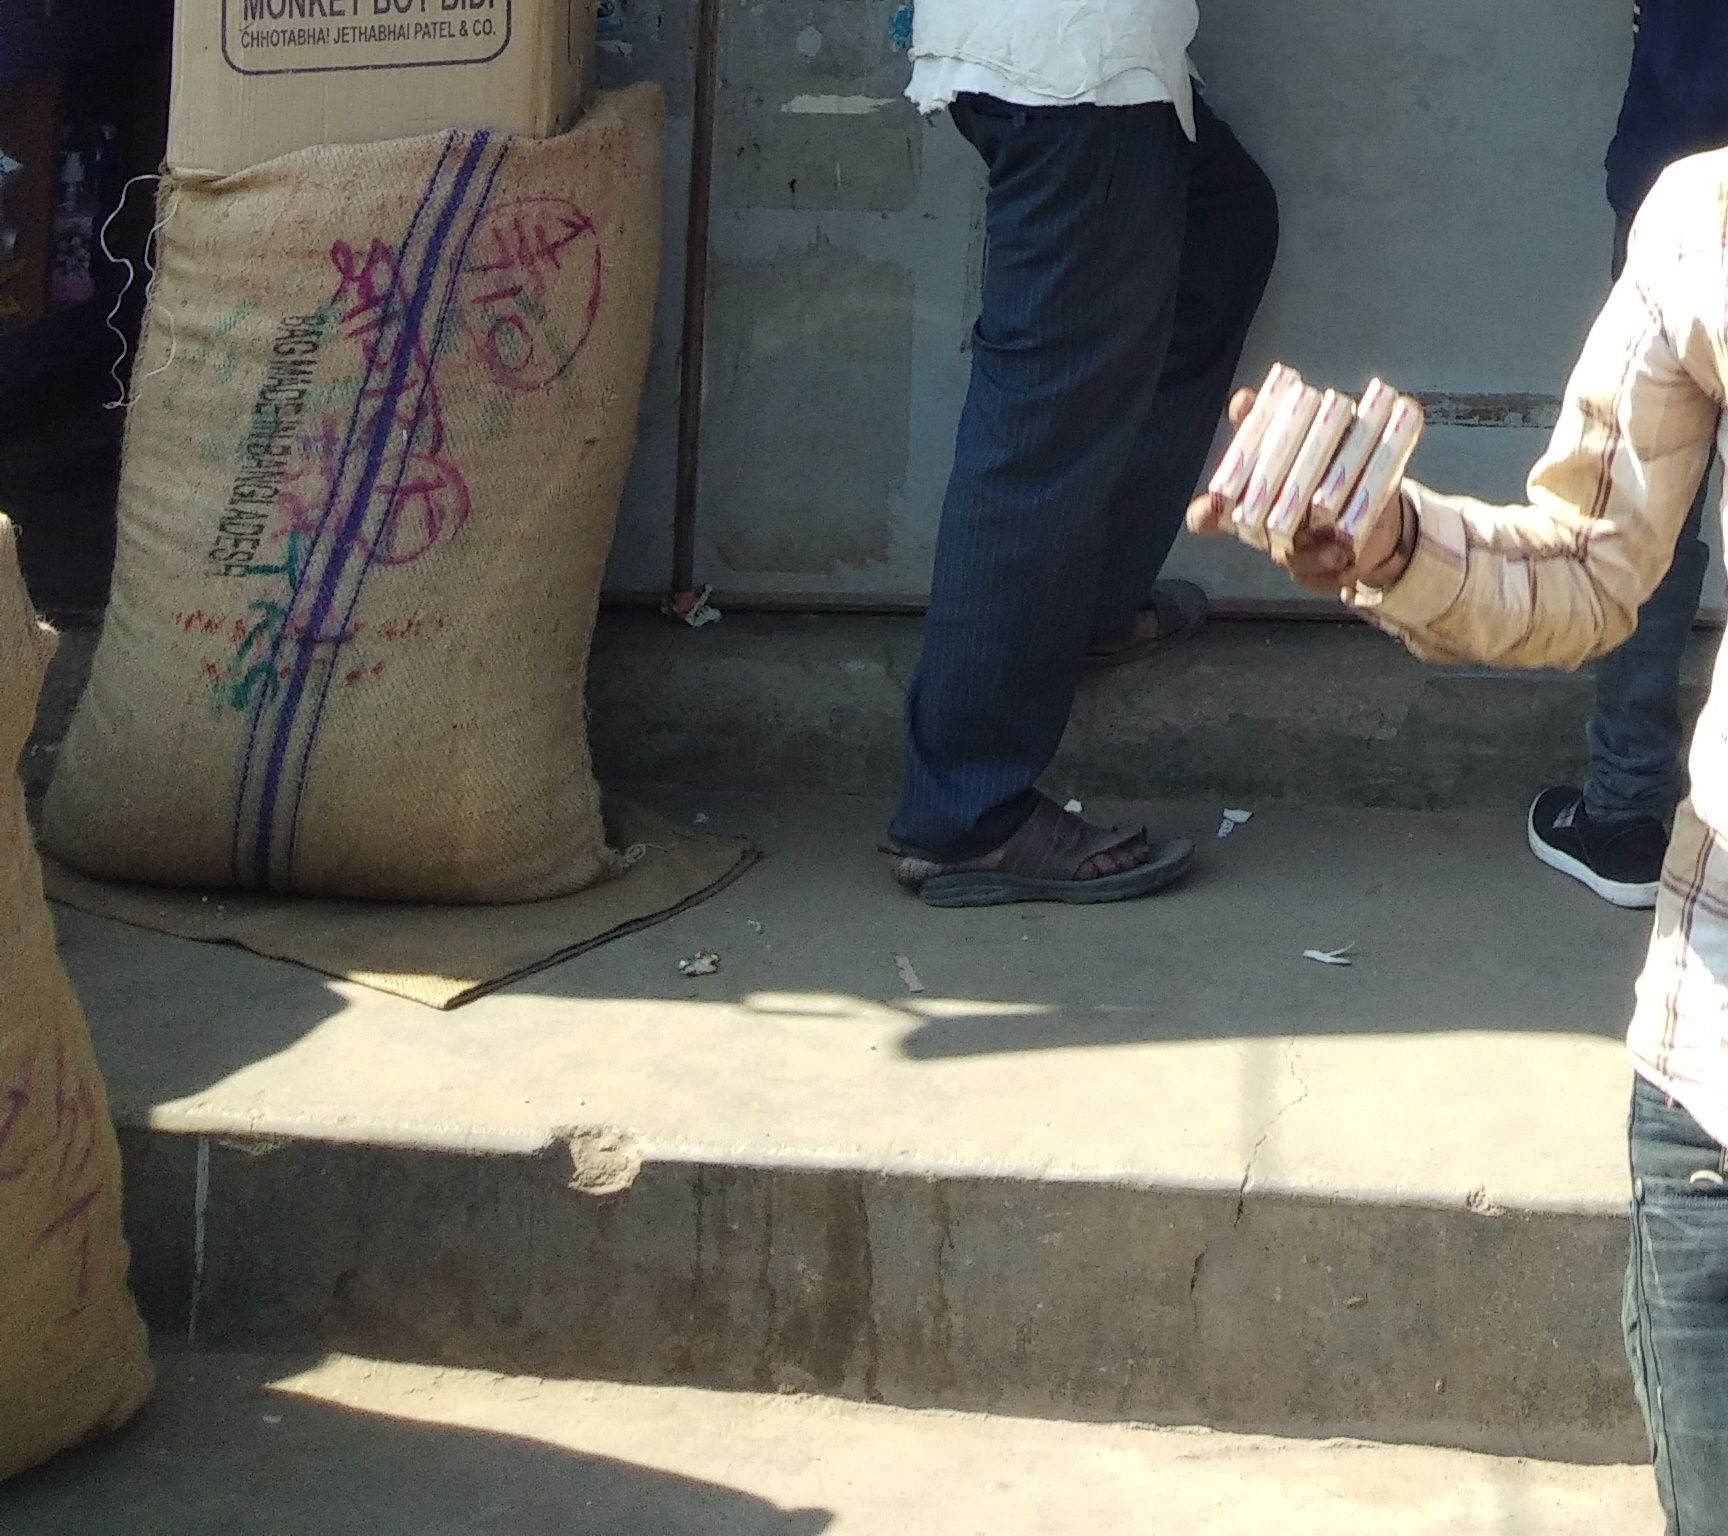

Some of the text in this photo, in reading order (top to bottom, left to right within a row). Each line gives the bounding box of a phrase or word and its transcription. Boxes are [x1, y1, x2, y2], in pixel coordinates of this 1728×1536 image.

[333, 24, 410, 44] JETHABHAI
[414, 21, 455, 40] PATEL
[459, 20, 468, 37] &
[472, 19, 496, 36] CO.
